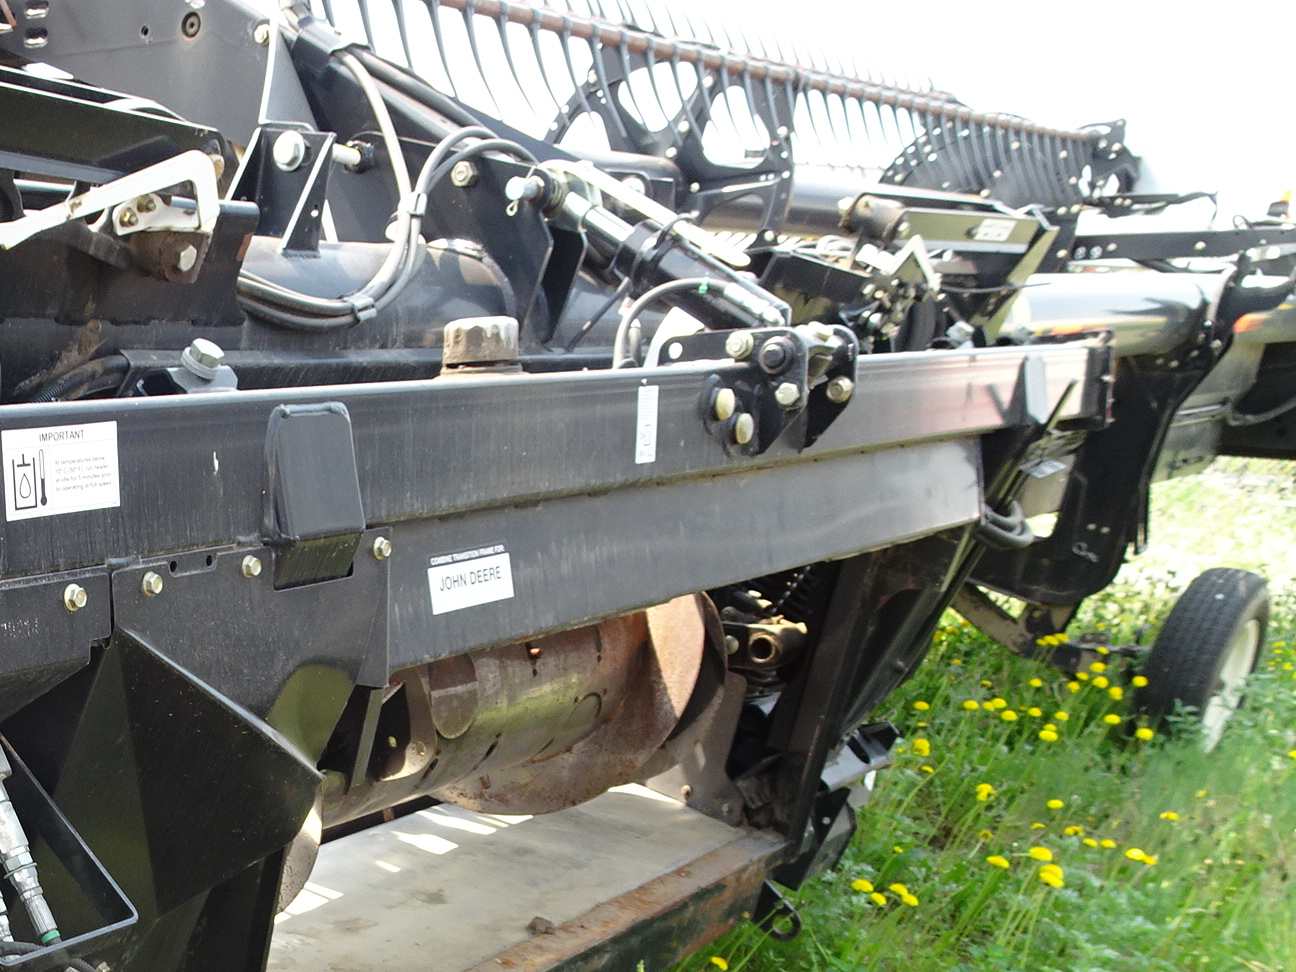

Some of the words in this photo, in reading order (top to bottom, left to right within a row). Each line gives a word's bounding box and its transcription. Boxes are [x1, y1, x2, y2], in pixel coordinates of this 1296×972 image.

[39, 430, 84, 442] IMPORTANT
[440, 573, 467, 592] JOHN
[470, 566, 502, 585] DEERE
